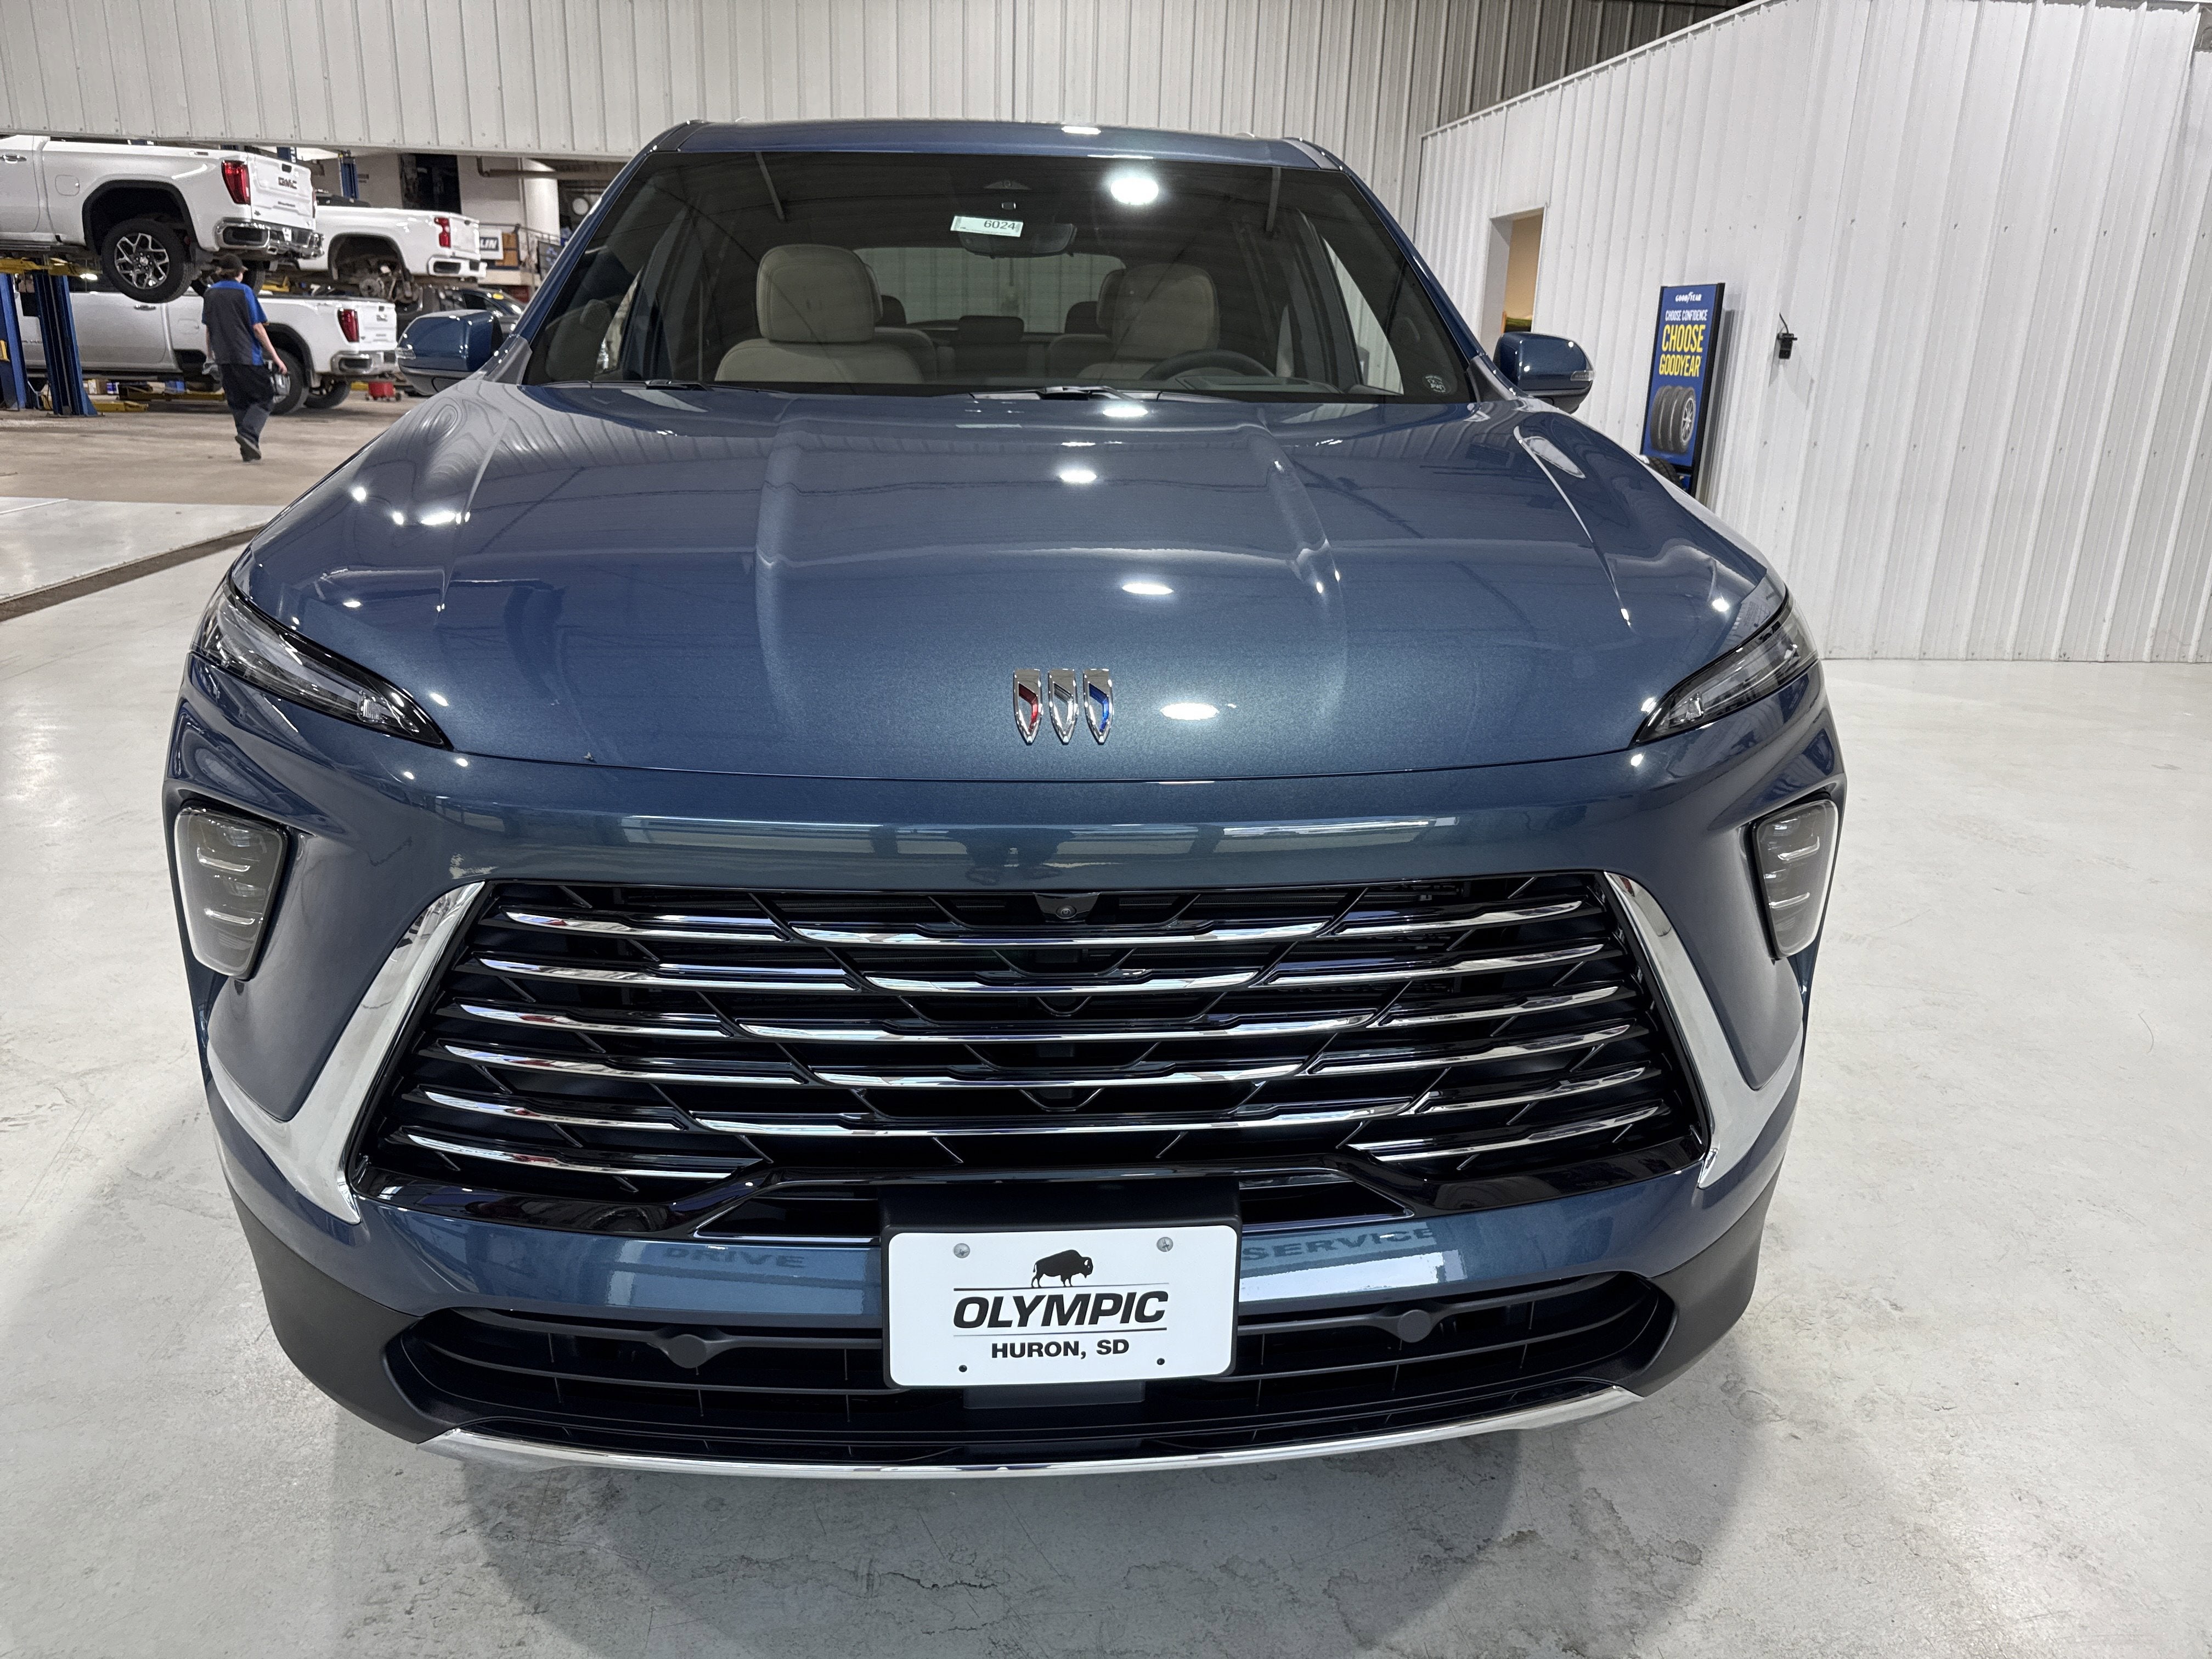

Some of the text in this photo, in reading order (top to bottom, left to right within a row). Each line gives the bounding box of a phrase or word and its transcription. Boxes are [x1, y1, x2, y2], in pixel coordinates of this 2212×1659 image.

[984, 220, 1016, 230] 6024
[1665, 309, 1708, 321] CHOOSE CONFIDENCE
[1662, 324, 1706, 352] CHOOSE
[1659, 354, 1701, 377] GOODYEAR
[1243, 1228, 1433, 1261] SERVICE
[665, 1247, 804, 1268] DRIVE
[953, 1291, 1169, 1328] OLYMPIC
[992, 1339, 1129, 1359] HURON, SD
